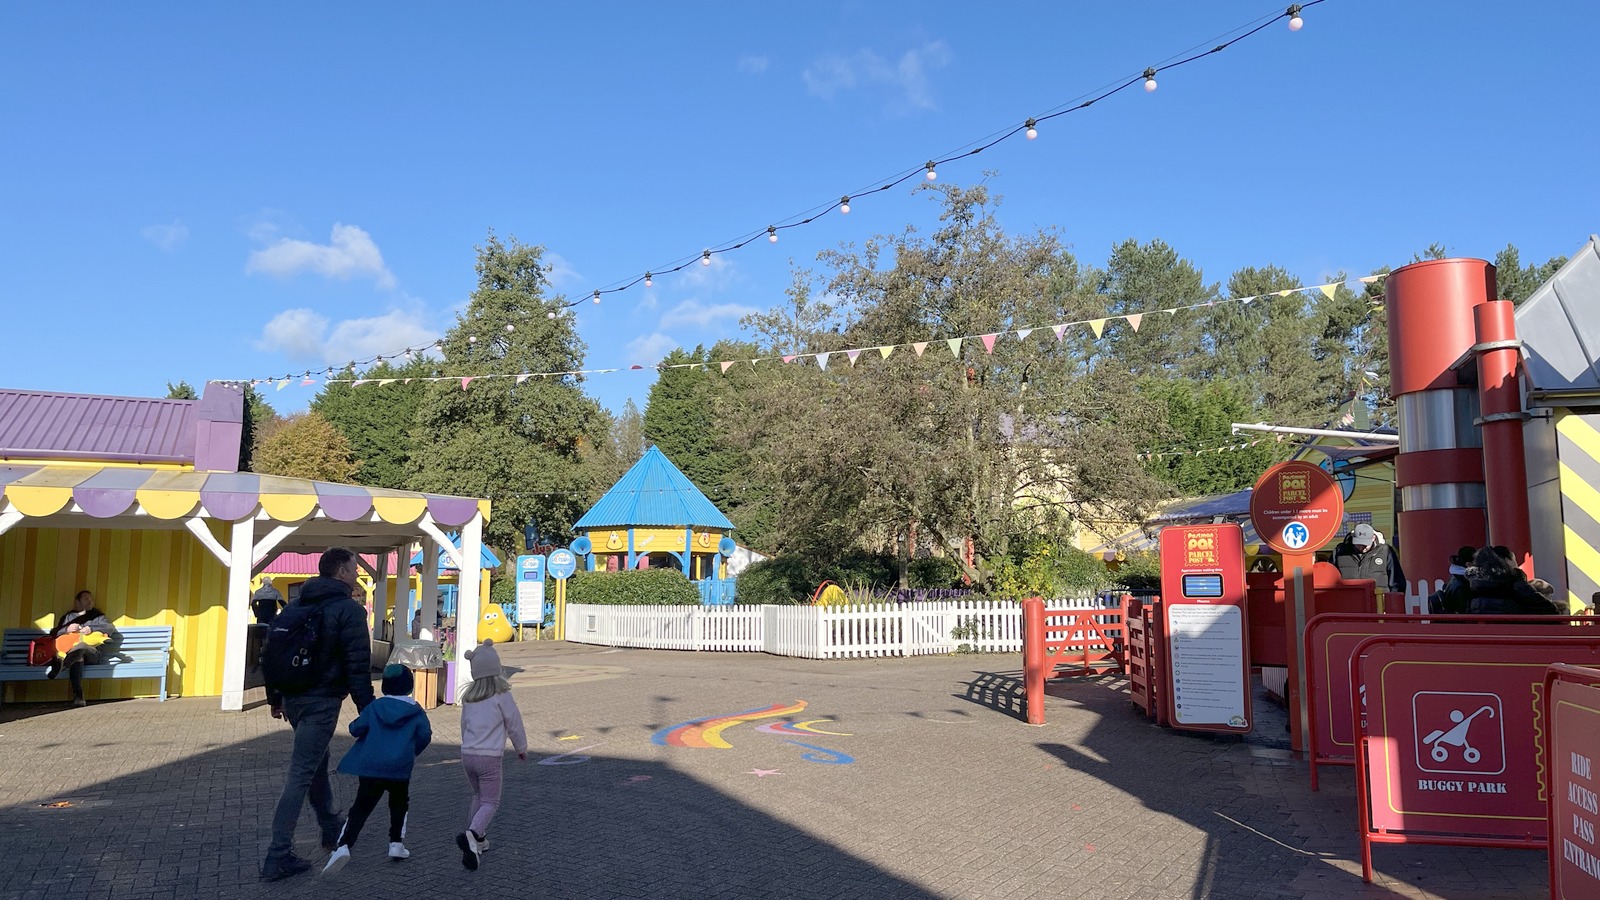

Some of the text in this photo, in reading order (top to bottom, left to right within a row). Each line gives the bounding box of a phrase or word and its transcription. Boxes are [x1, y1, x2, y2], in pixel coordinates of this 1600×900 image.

[1571, 752, 1592, 780] RIDE
[1418, 780, 1507, 793] BUGGY PARK
[1568, 782, 1598, 815] ACCESS
[1573, 813, 1595, 845] PASS
